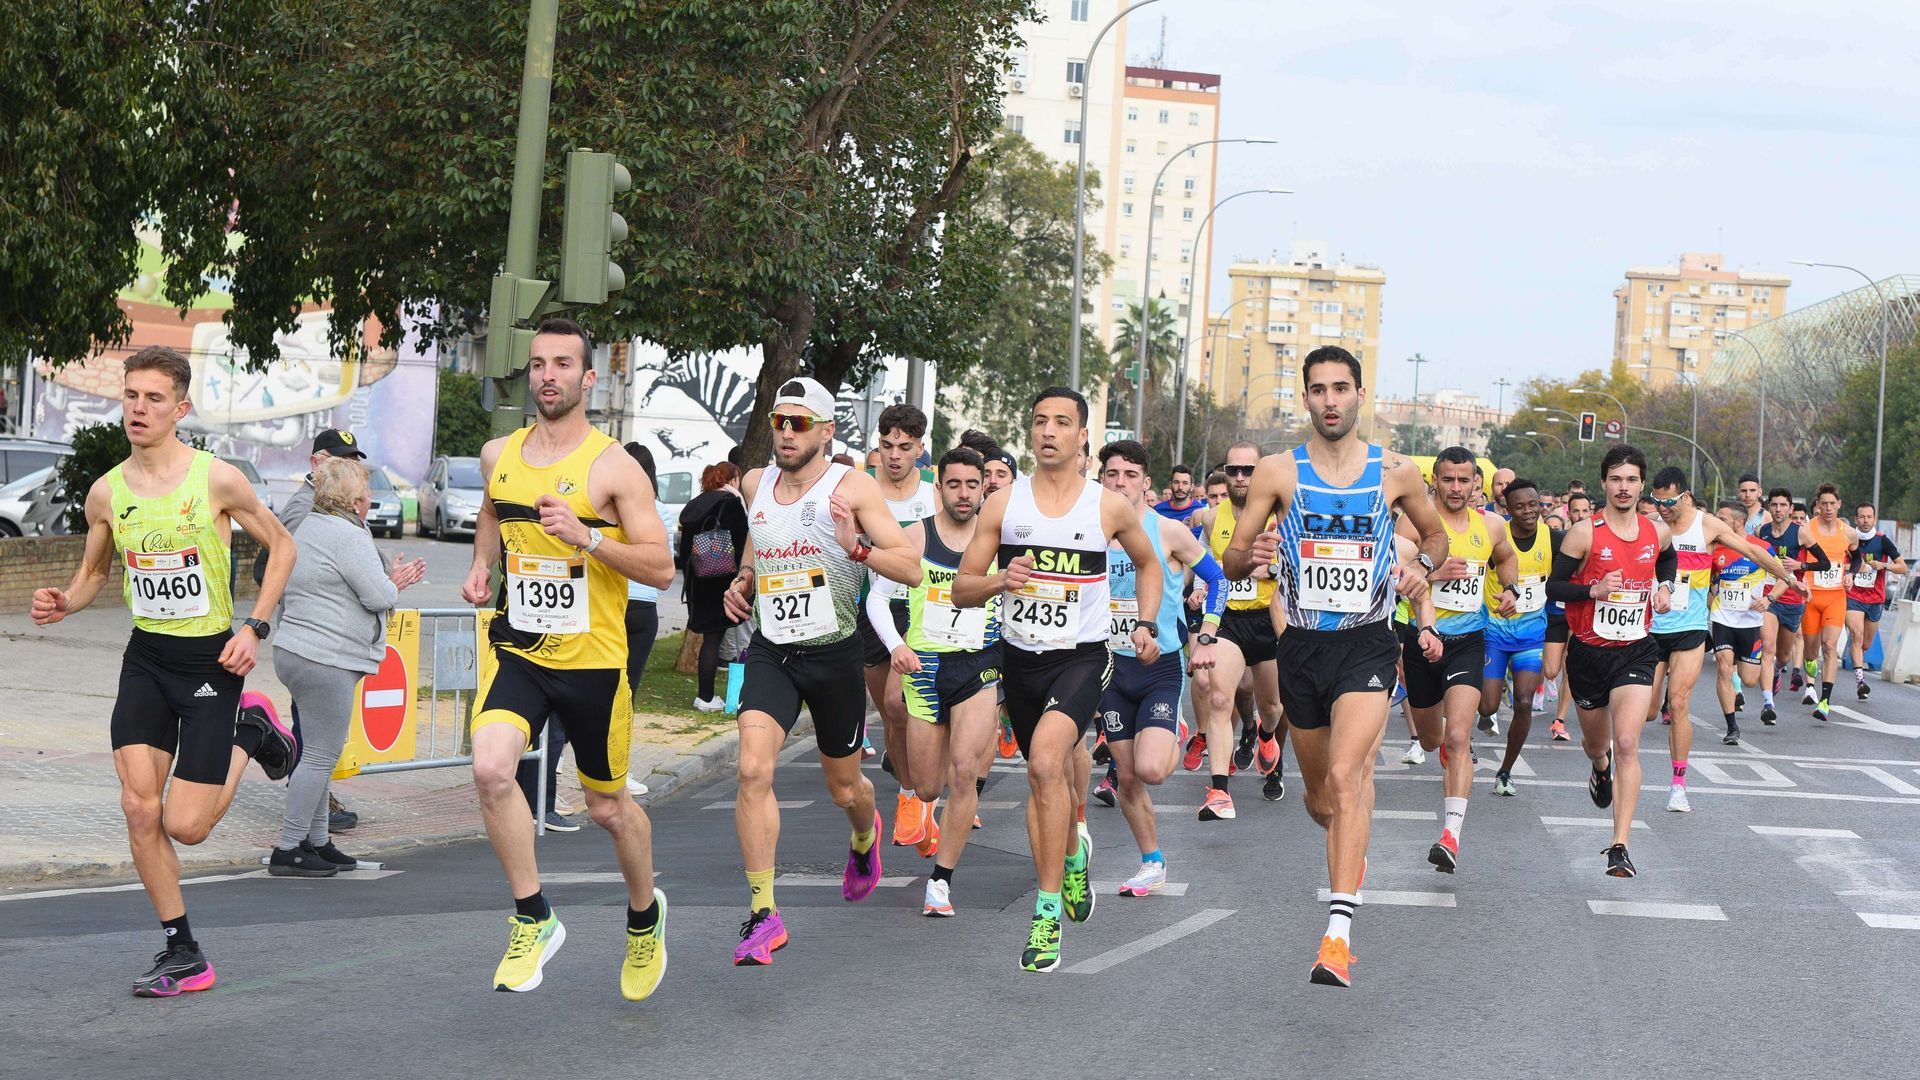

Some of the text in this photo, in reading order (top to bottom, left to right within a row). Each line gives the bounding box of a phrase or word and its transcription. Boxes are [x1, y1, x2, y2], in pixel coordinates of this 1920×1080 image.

[1303, 514, 1372, 534] CAR
[770, 562, 803, 572] JEREZ
[1024, 548, 1080, 574] ASM
[1109, 560, 1136, 577] rja
[1303, 565, 1368, 592] 10393
[1820, 570, 1839, 580] 1567
[133, 573, 202, 600] 10460
[516, 580, 575, 609] 1399
[1440, 578, 1479, 596] 2436
[1525, 588, 1533, 600] 5
[1723, 590, 1745, 602] 1971
[773, 593, 811, 621] 327
[1012, 599, 1068, 628] 2435
[1598, 606, 1643, 626] 10647
[951, 609, 961, 628] 7
